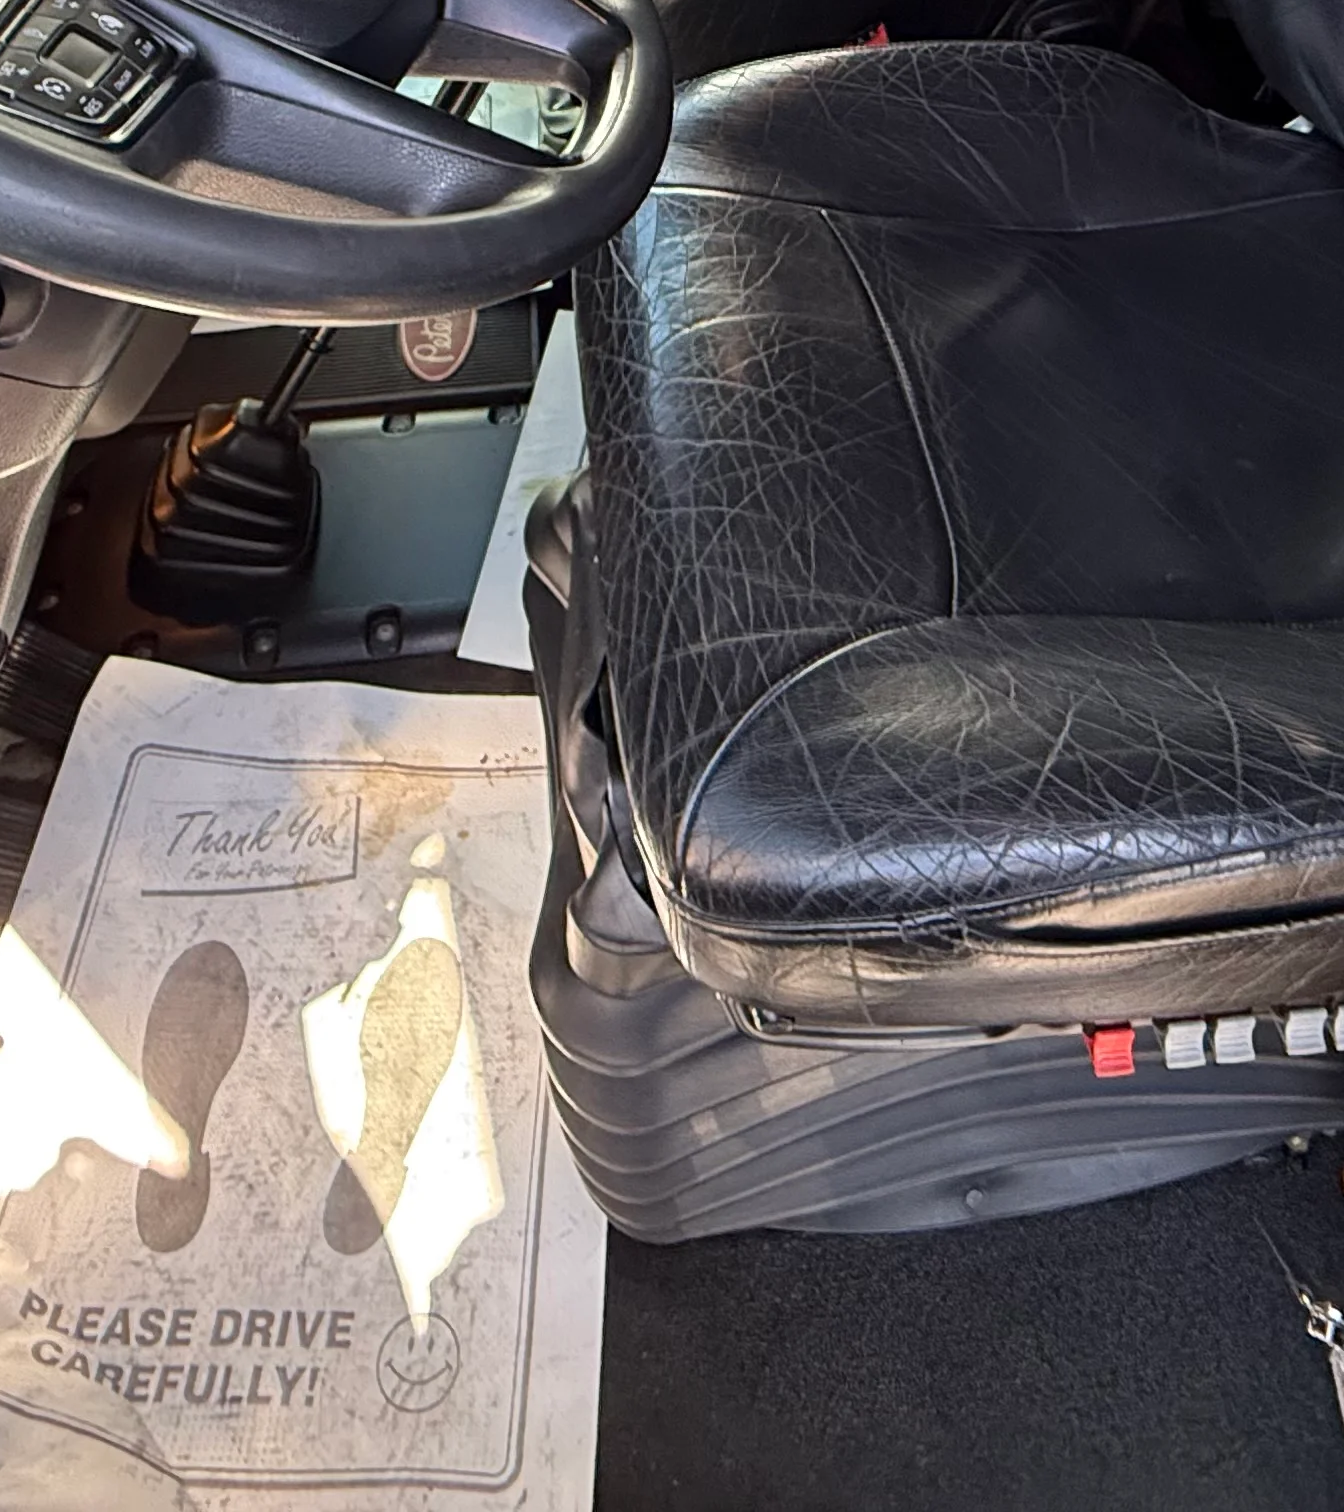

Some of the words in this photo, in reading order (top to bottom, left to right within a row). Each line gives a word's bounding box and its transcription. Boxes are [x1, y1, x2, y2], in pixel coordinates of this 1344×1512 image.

[167, 808, 280, 857] Thank
[288, 804, 338, 854] You
[19, 1288, 198, 1348] PLEASE
[209, 1308, 356, 1350] DRIVE
[30, 1338, 320, 1407] CAREFULLY!
